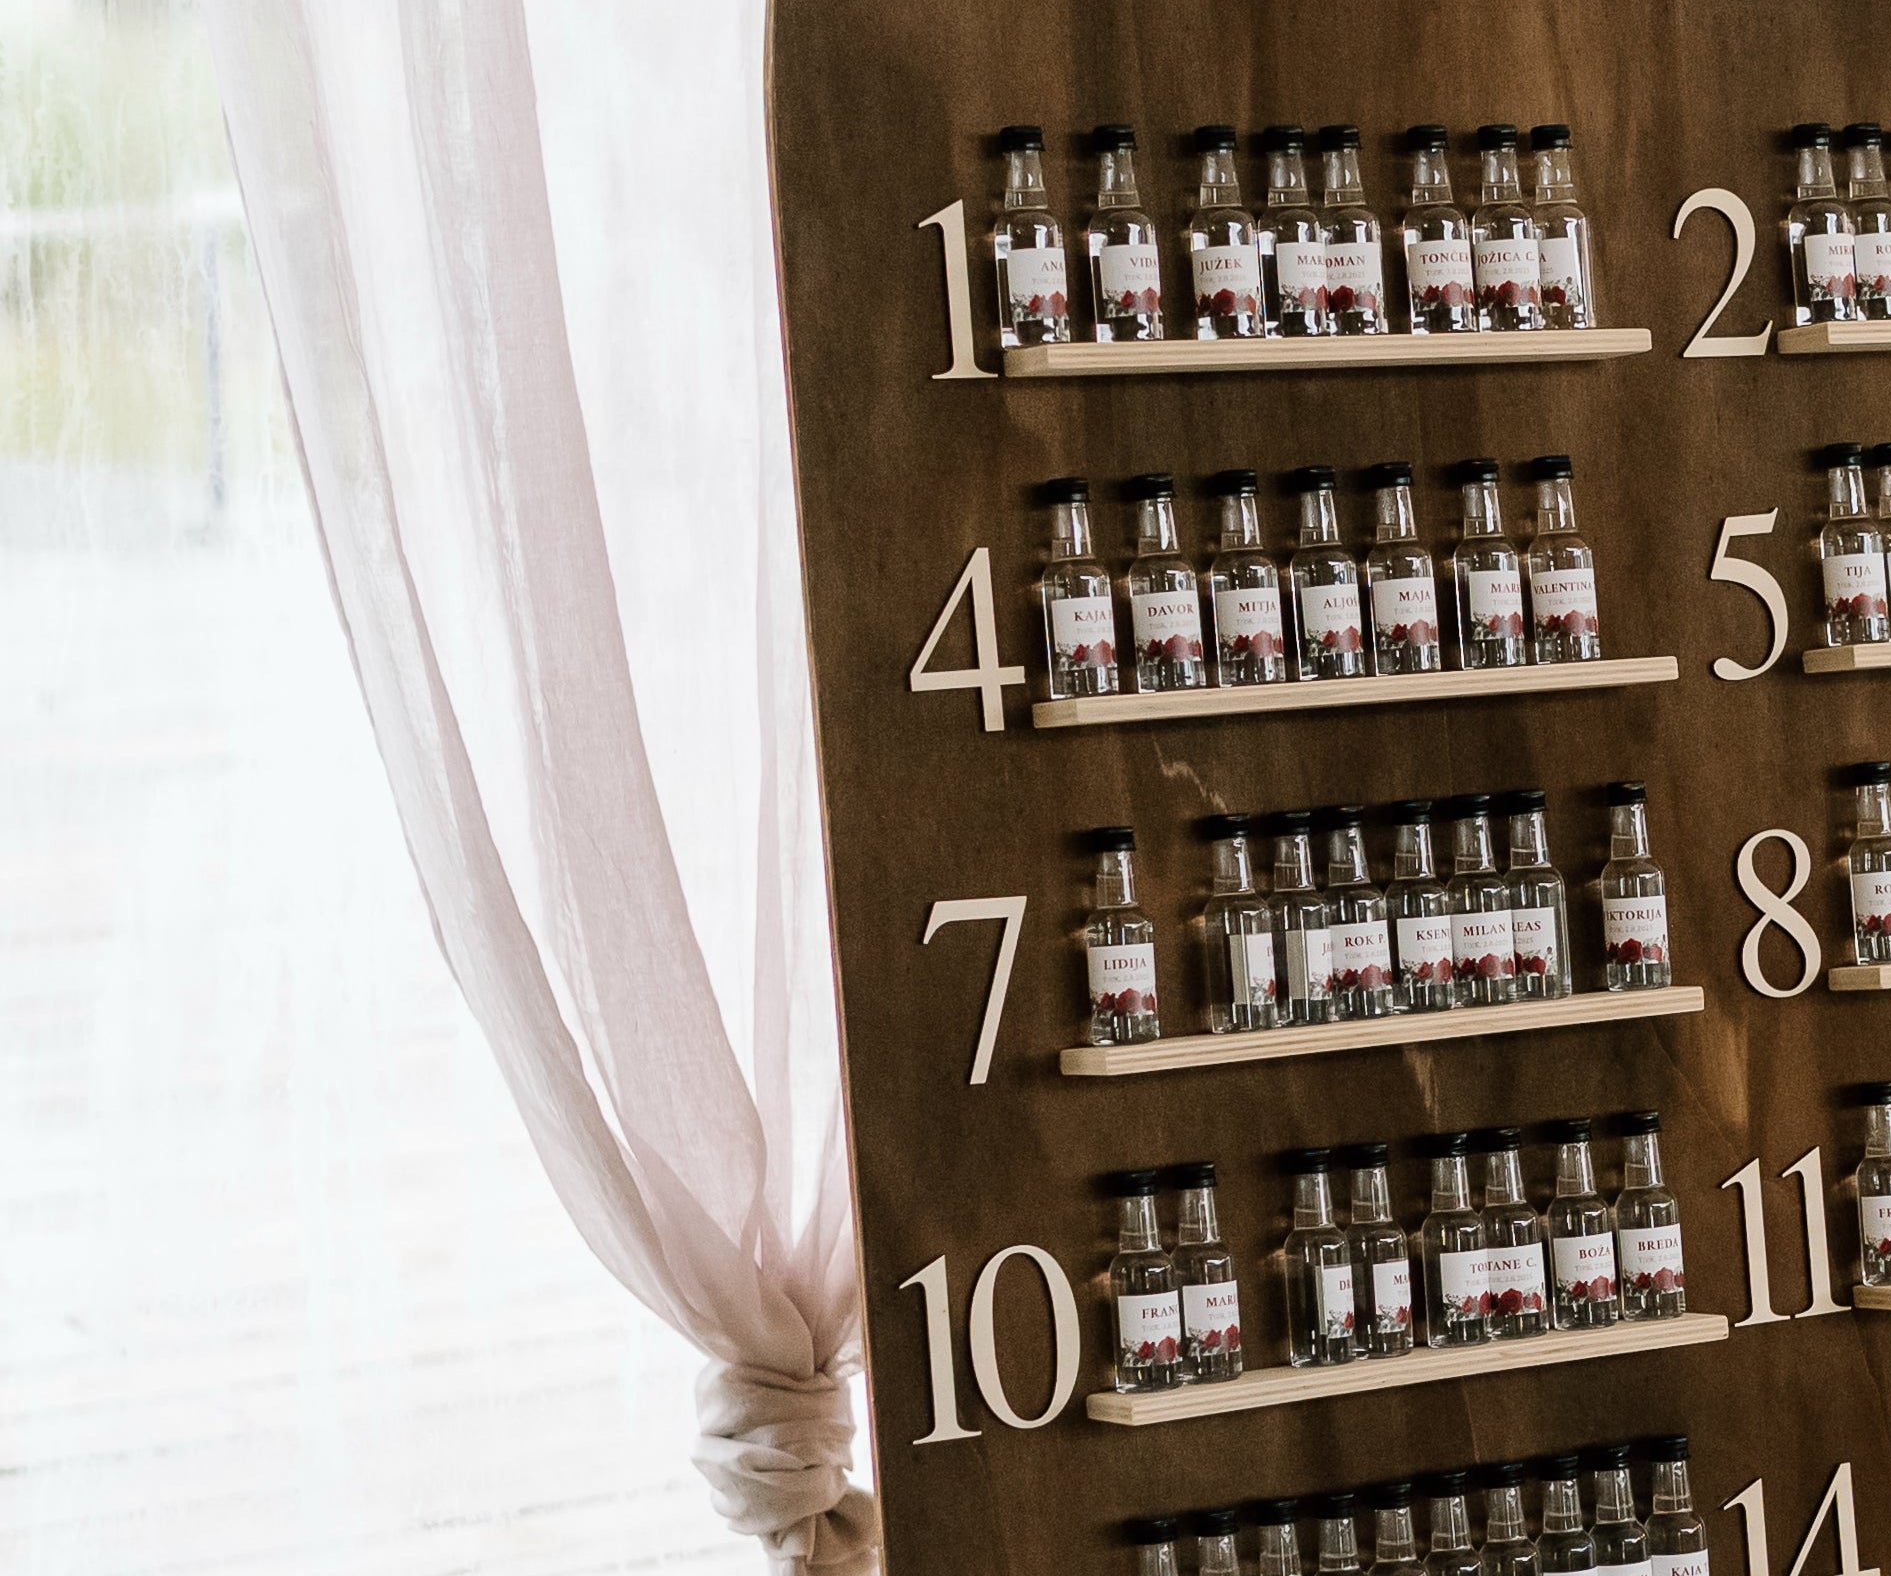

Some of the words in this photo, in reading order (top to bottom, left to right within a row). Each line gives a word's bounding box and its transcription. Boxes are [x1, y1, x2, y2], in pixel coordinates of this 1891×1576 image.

[1673, 187, 1773, 359] 2
[918, 199, 998, 381] 1
[1844, 565, 1872, 577] TIJA
[1399, 589, 1431, 603] MAJA
[1710, 507, 1789, 681] 5
[1148, 603, 1194, 617] DAVOR
[1238, 601, 1277, 614] MITJA
[910, 547, 1026, 732] 4
[1737, 829, 1822, 998] 8
[1463, 923, 1506, 937] MILAN
[1344, 935, 1374, 947] ROK
[1103, 957, 1147, 971] LIDIJA
[923, 895, 1027, 1085] 7
[1638, 1237, 1679, 1252] BREDA
[1722, 1146, 1853, 1328] 11
[1526, 1257, 1537, 1268] C.
[898, 1244, 1081, 1445] 10
